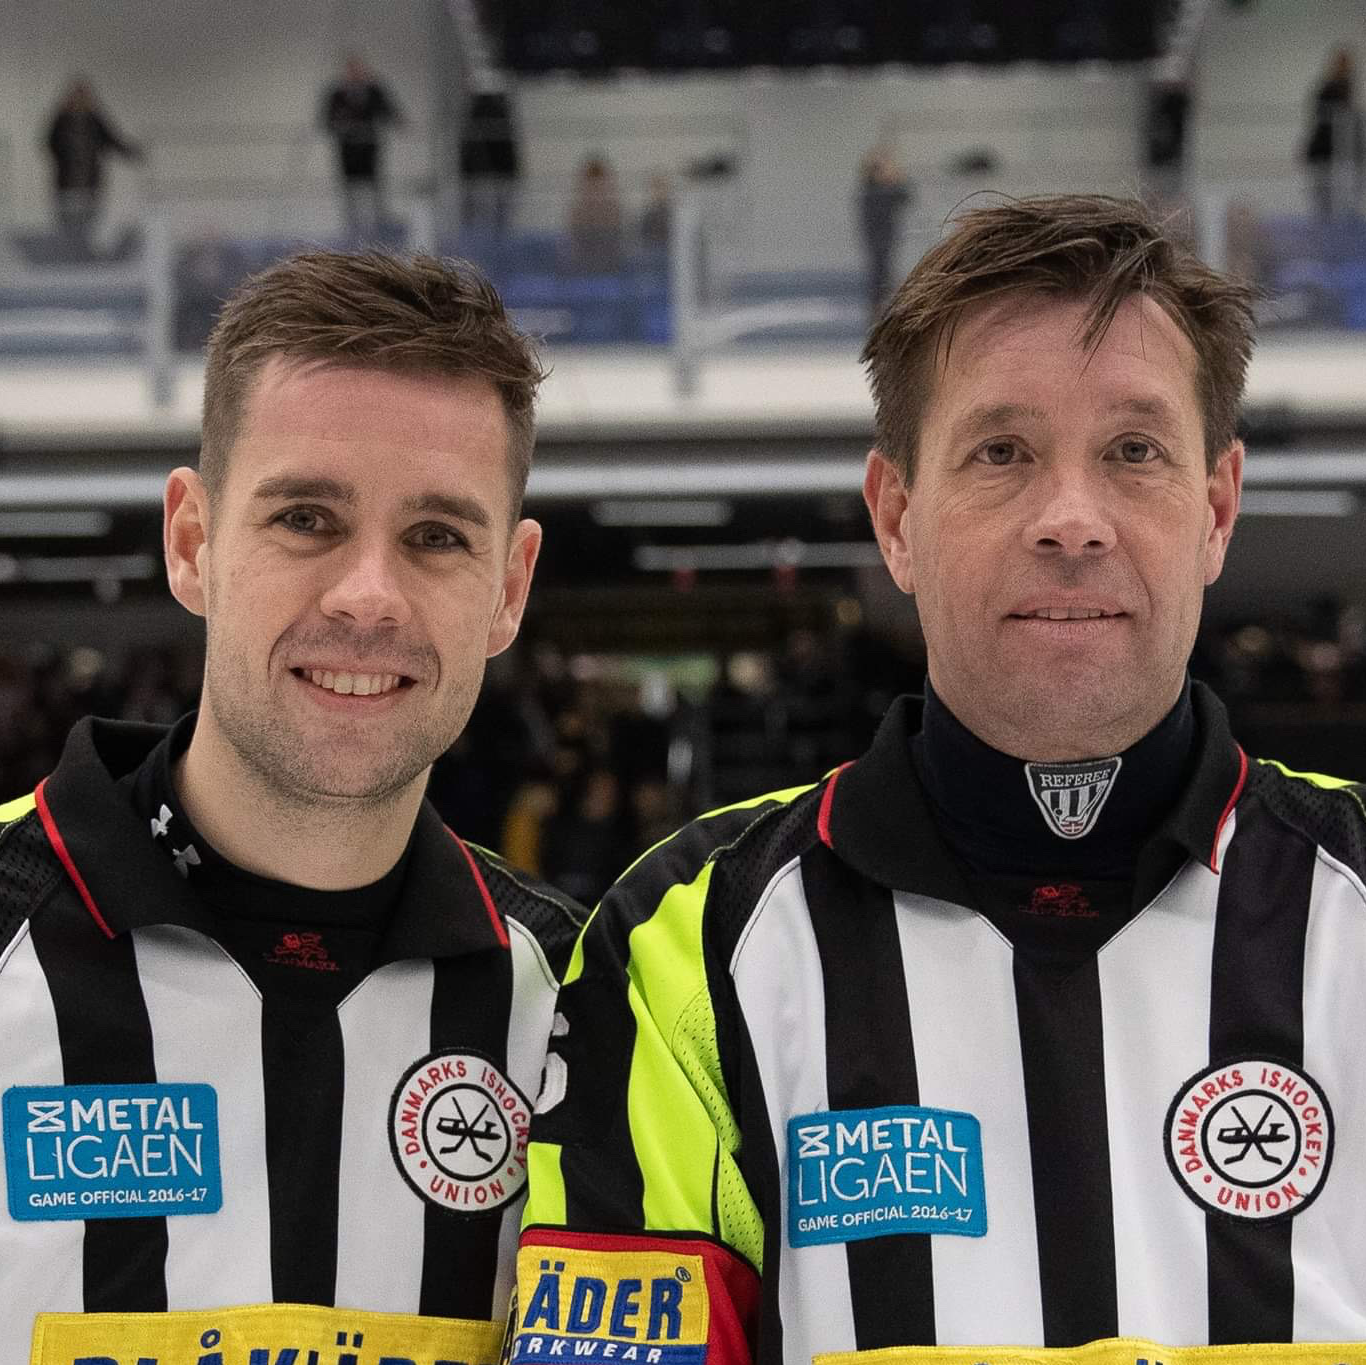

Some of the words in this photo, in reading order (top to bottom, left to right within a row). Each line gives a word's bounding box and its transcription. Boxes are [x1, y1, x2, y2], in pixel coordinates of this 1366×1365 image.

[1039, 769, 1111, 788] REFEREE
[70, 1097, 204, 1132] METAL
[401, 1060, 467, 1155] DANMARKS
[480, 1066, 530, 1168] ISHOCKEY
[1177, 1069, 1244, 1173] DANMARKS
[1260, 1068, 1323, 1168] ISHOCKEY
[835, 1117, 968, 1155] METAL
[26, 1134, 203, 1180] LIGAEN
[429, 1175, 505, 1204] UNION
[798, 1151, 968, 1206] LIGAEN
[29, 1192, 76, 1208] GAME
[80, 1190, 146, 1205] OFFICIAL
[147, 1187, 209, 1203] 2016-17
[1217, 1182, 1300, 1212] UNION
[798, 1214, 838, 1232] GAME
[842, 1205, 909, 1227] OFFICIAL
[911, 1204, 973, 1223] 2016-17
